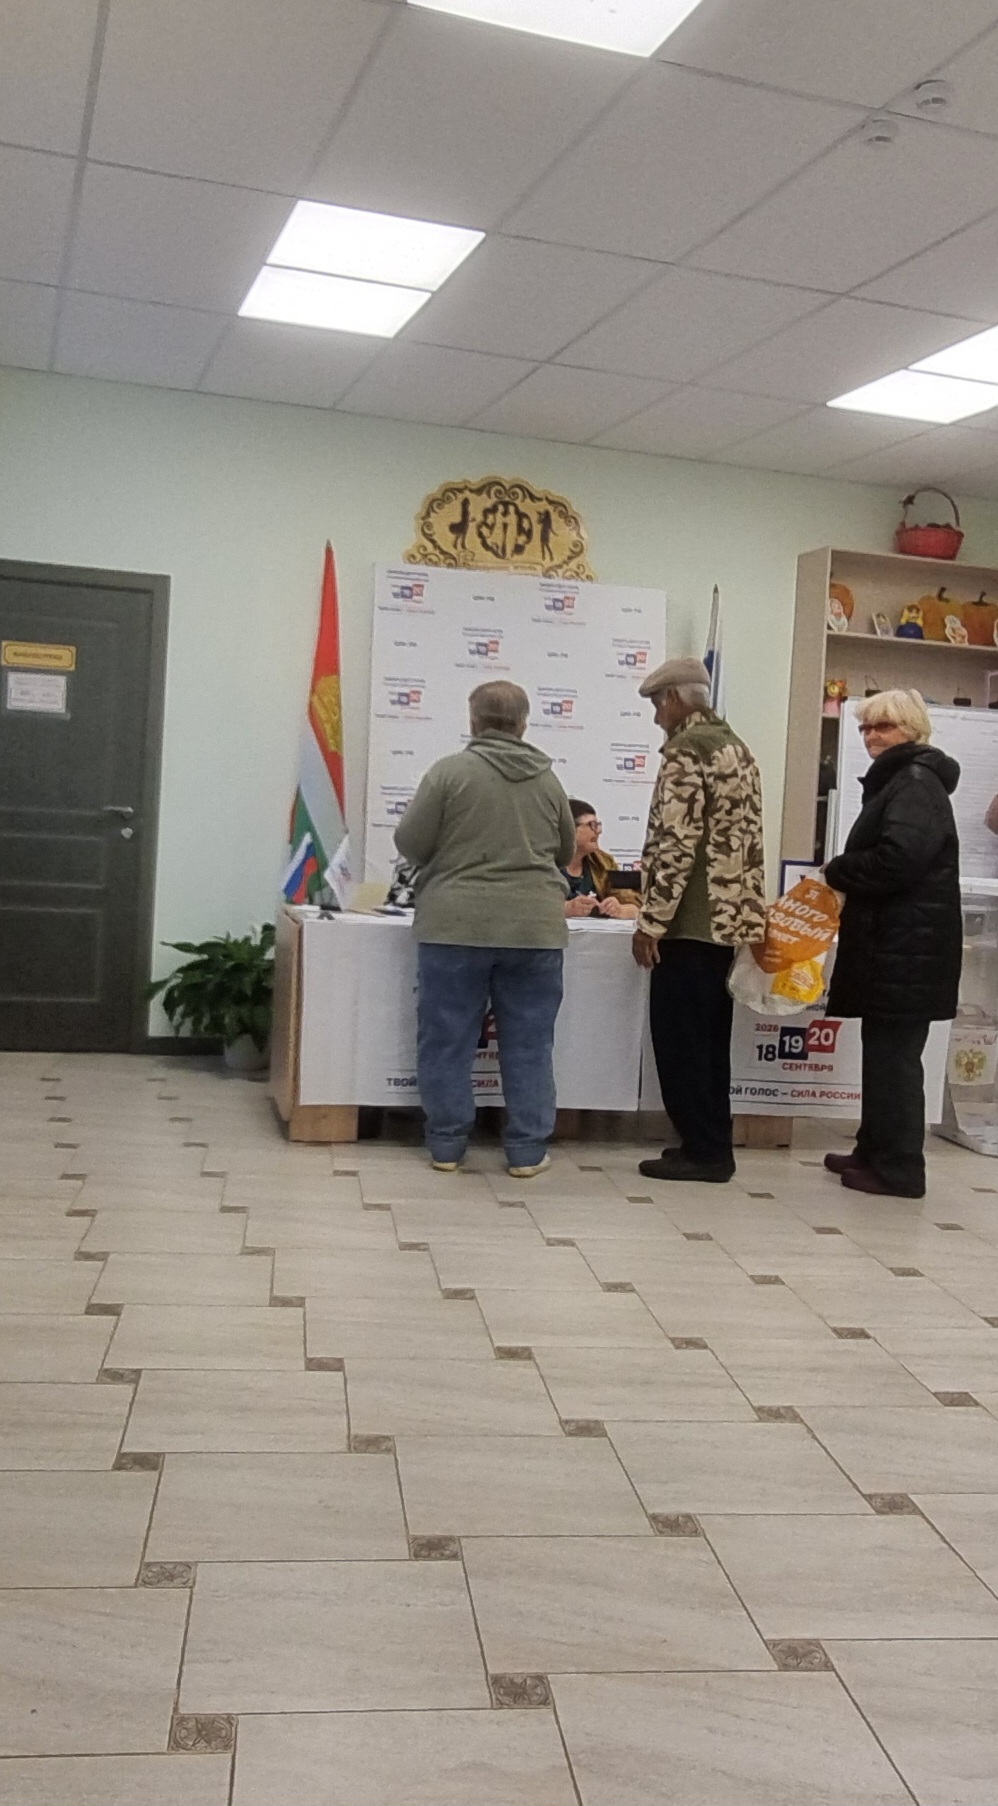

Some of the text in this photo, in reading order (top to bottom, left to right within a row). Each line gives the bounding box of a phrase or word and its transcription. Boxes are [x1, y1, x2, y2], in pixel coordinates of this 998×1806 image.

[755, 1023, 779, 1033] 2026
[756, 1027, 834, 1062] 18 19 20
[782, 1062, 834, 1072] СЕНТЯБРЯ
[744, 1086, 779, 1097] ГОЛОС
[790, 1088, 817, 1098] СИЛА
[819, 1090, 861, 1100] РОССИИ
